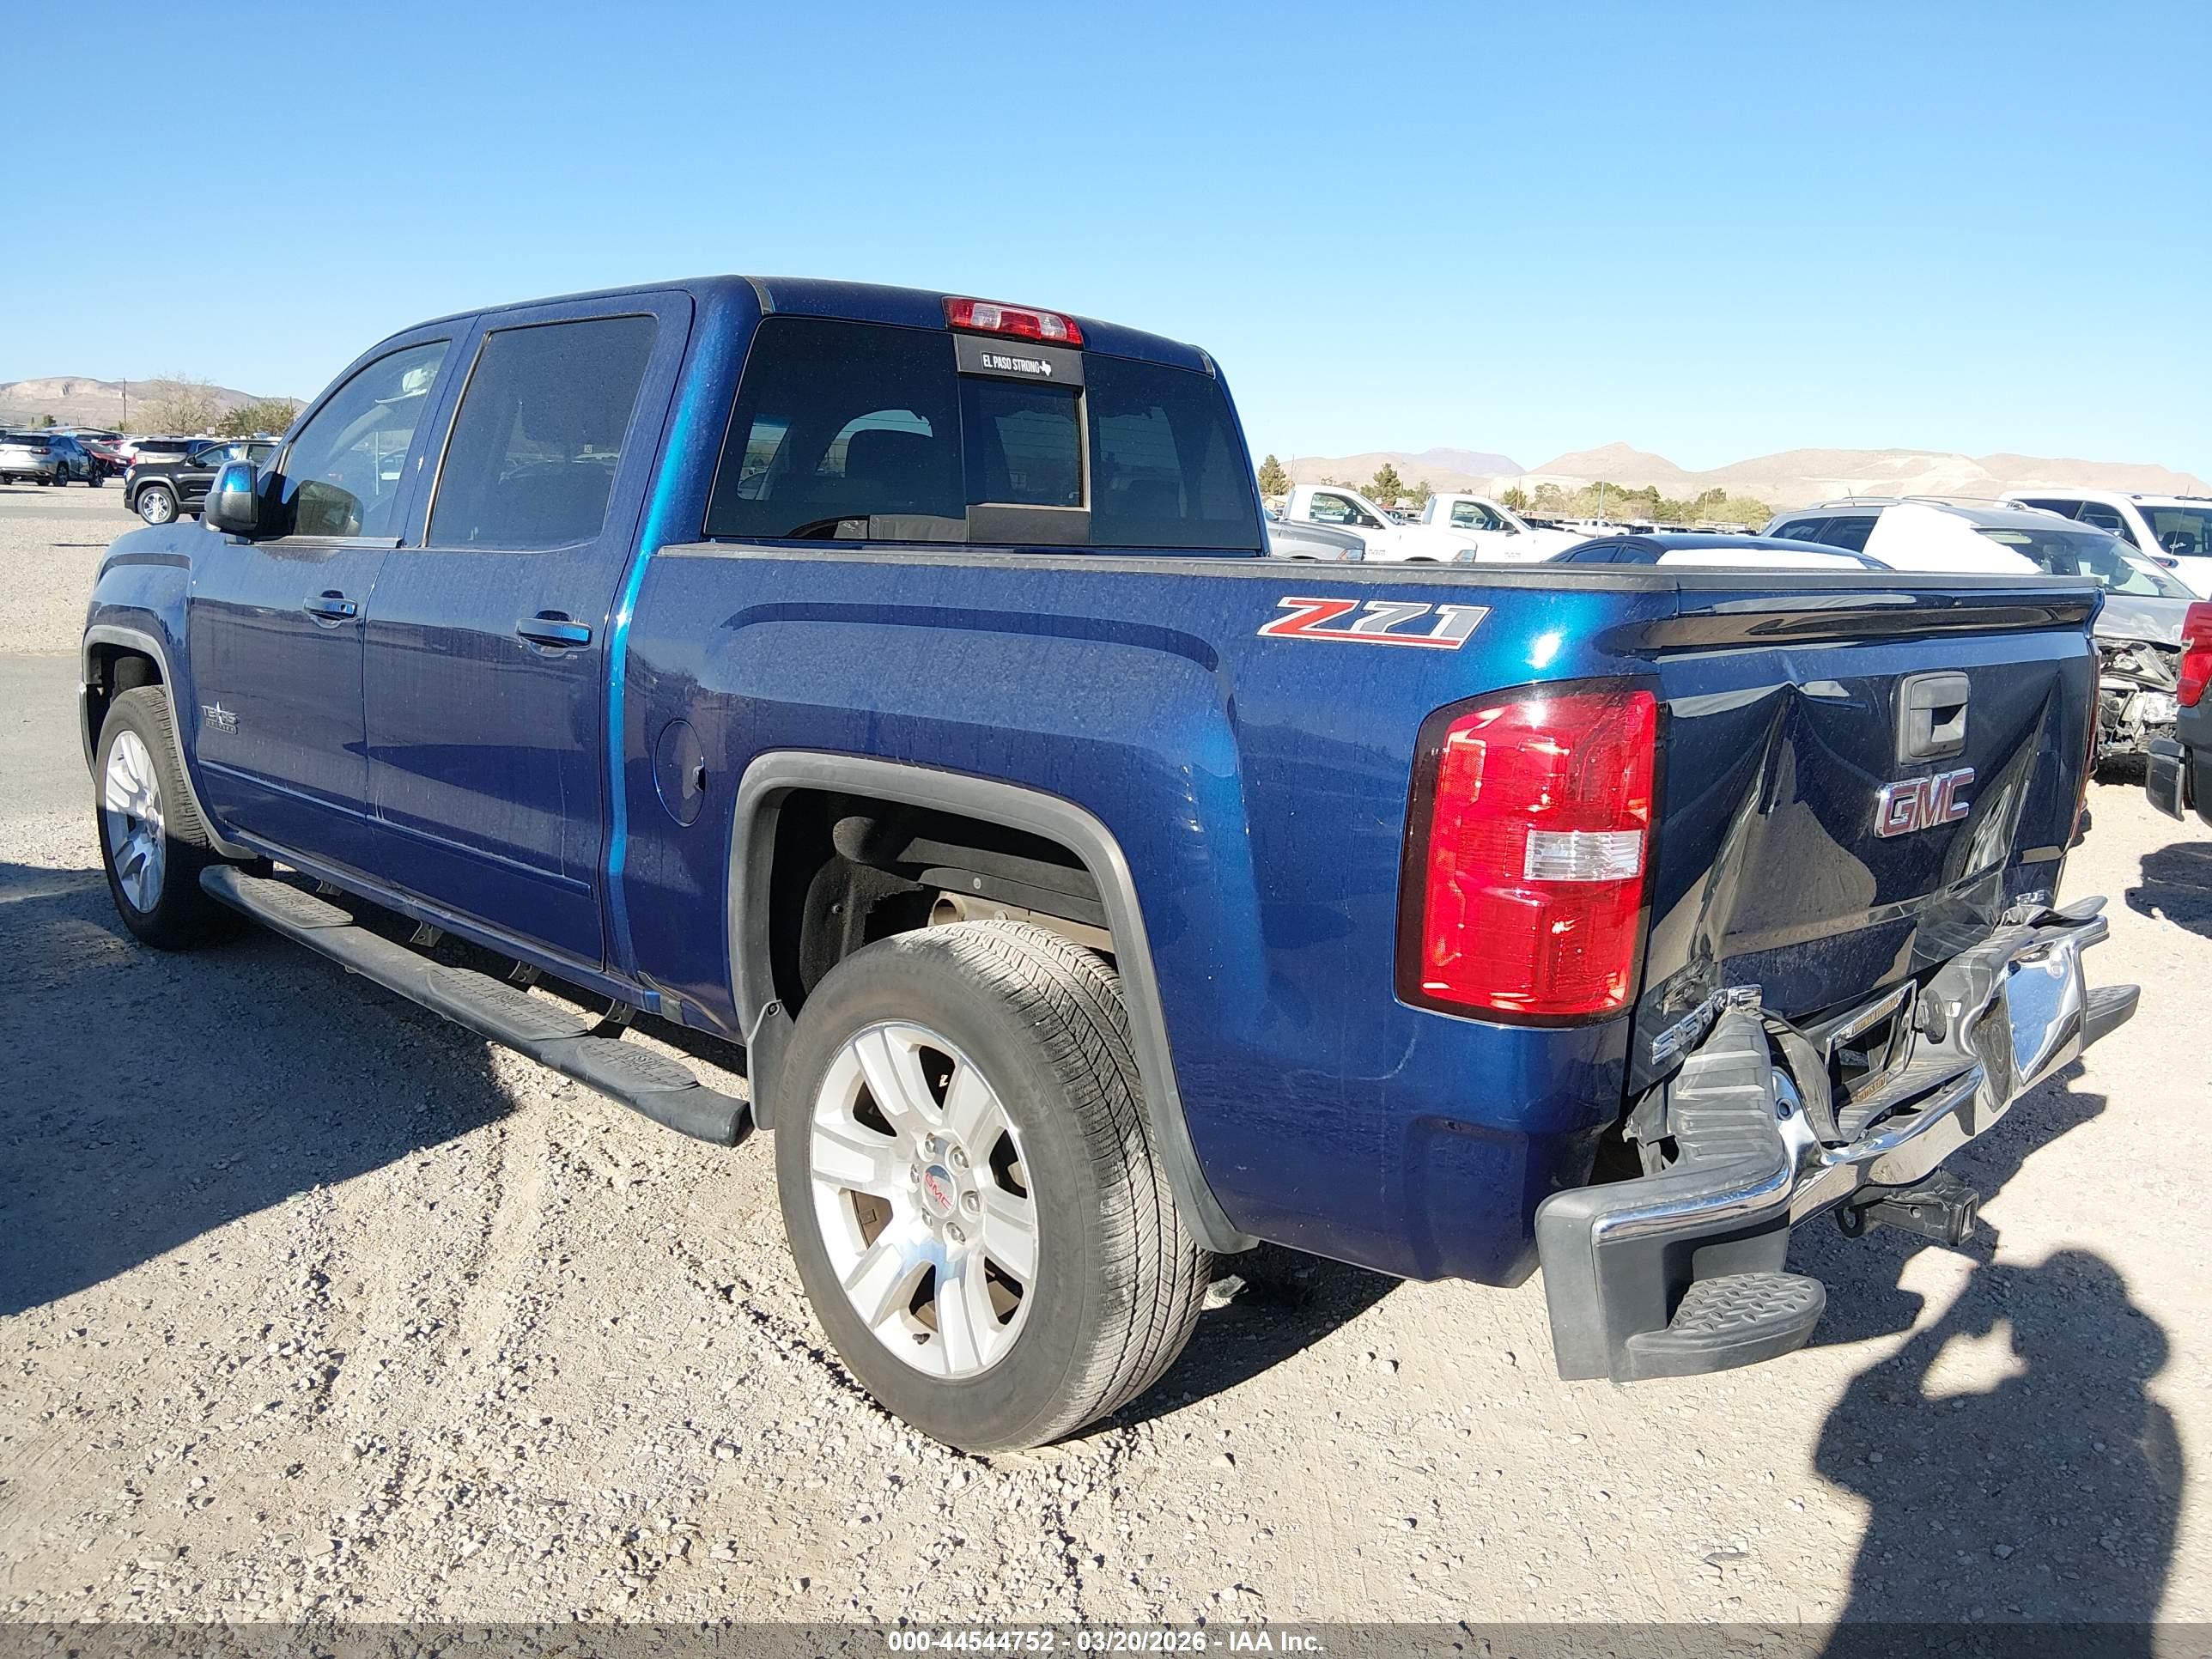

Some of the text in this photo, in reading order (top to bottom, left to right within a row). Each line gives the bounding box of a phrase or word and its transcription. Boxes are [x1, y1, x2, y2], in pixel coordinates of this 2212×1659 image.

[982, 354, 1040, 374] EL PASO STRONG
[1256, 596, 1493, 650] Z71
[1875, 768, 1975, 838] GMC
[925, 1170, 952, 1210] GMC
